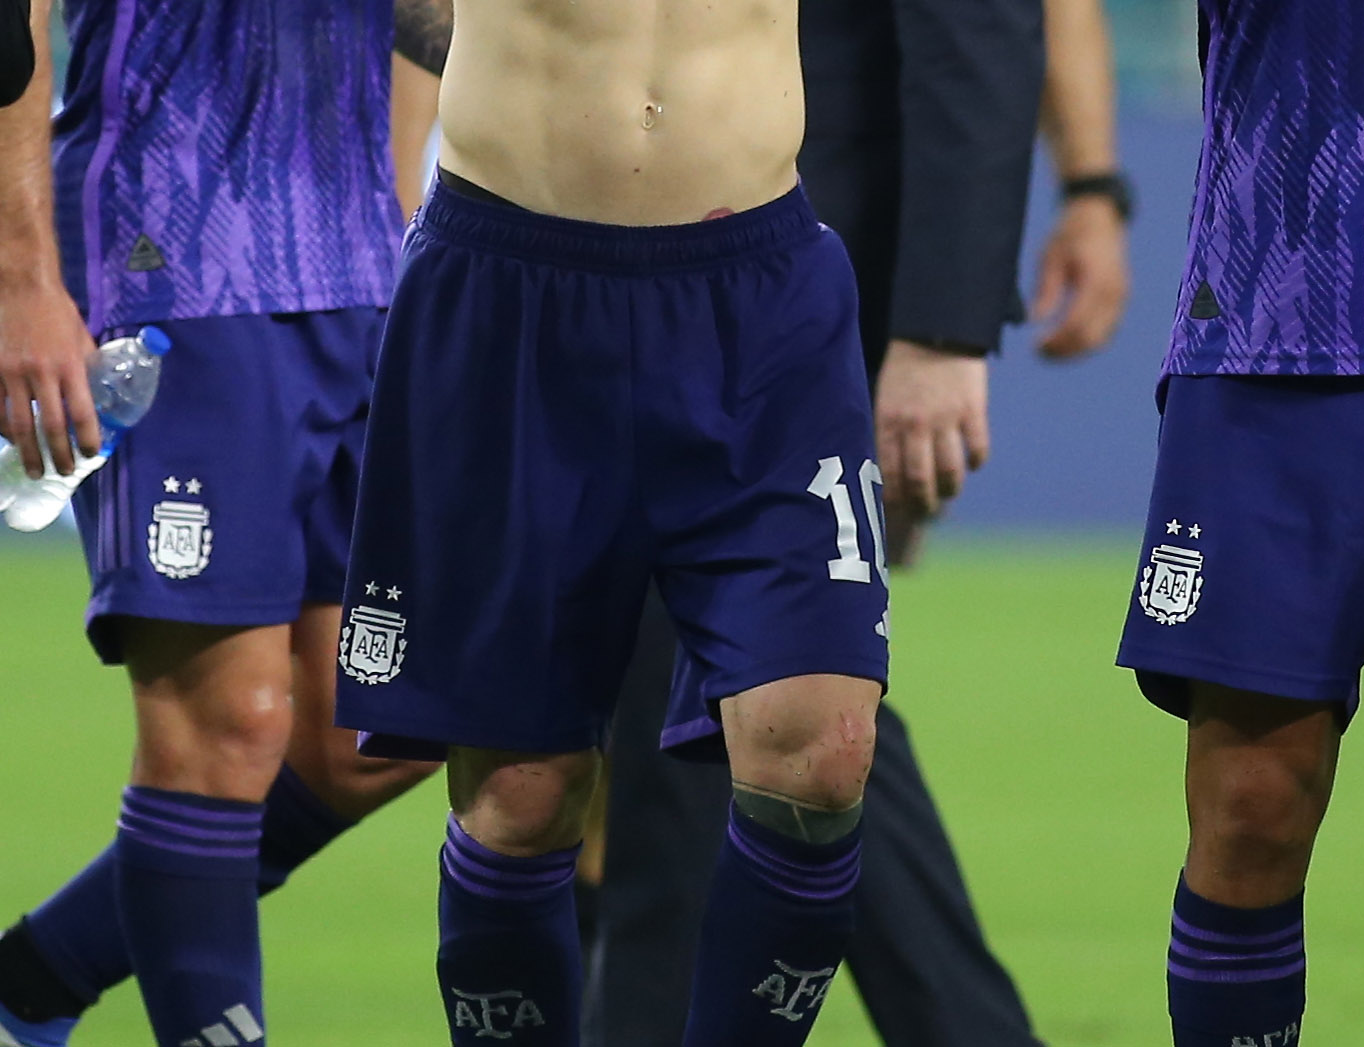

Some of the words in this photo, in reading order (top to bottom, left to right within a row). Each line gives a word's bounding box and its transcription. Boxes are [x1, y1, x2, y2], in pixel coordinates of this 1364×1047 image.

[1155, 566, 1188, 603] AFA
[355, 627, 388, 663] AFA
[452, 987, 545, 1039] AFA
